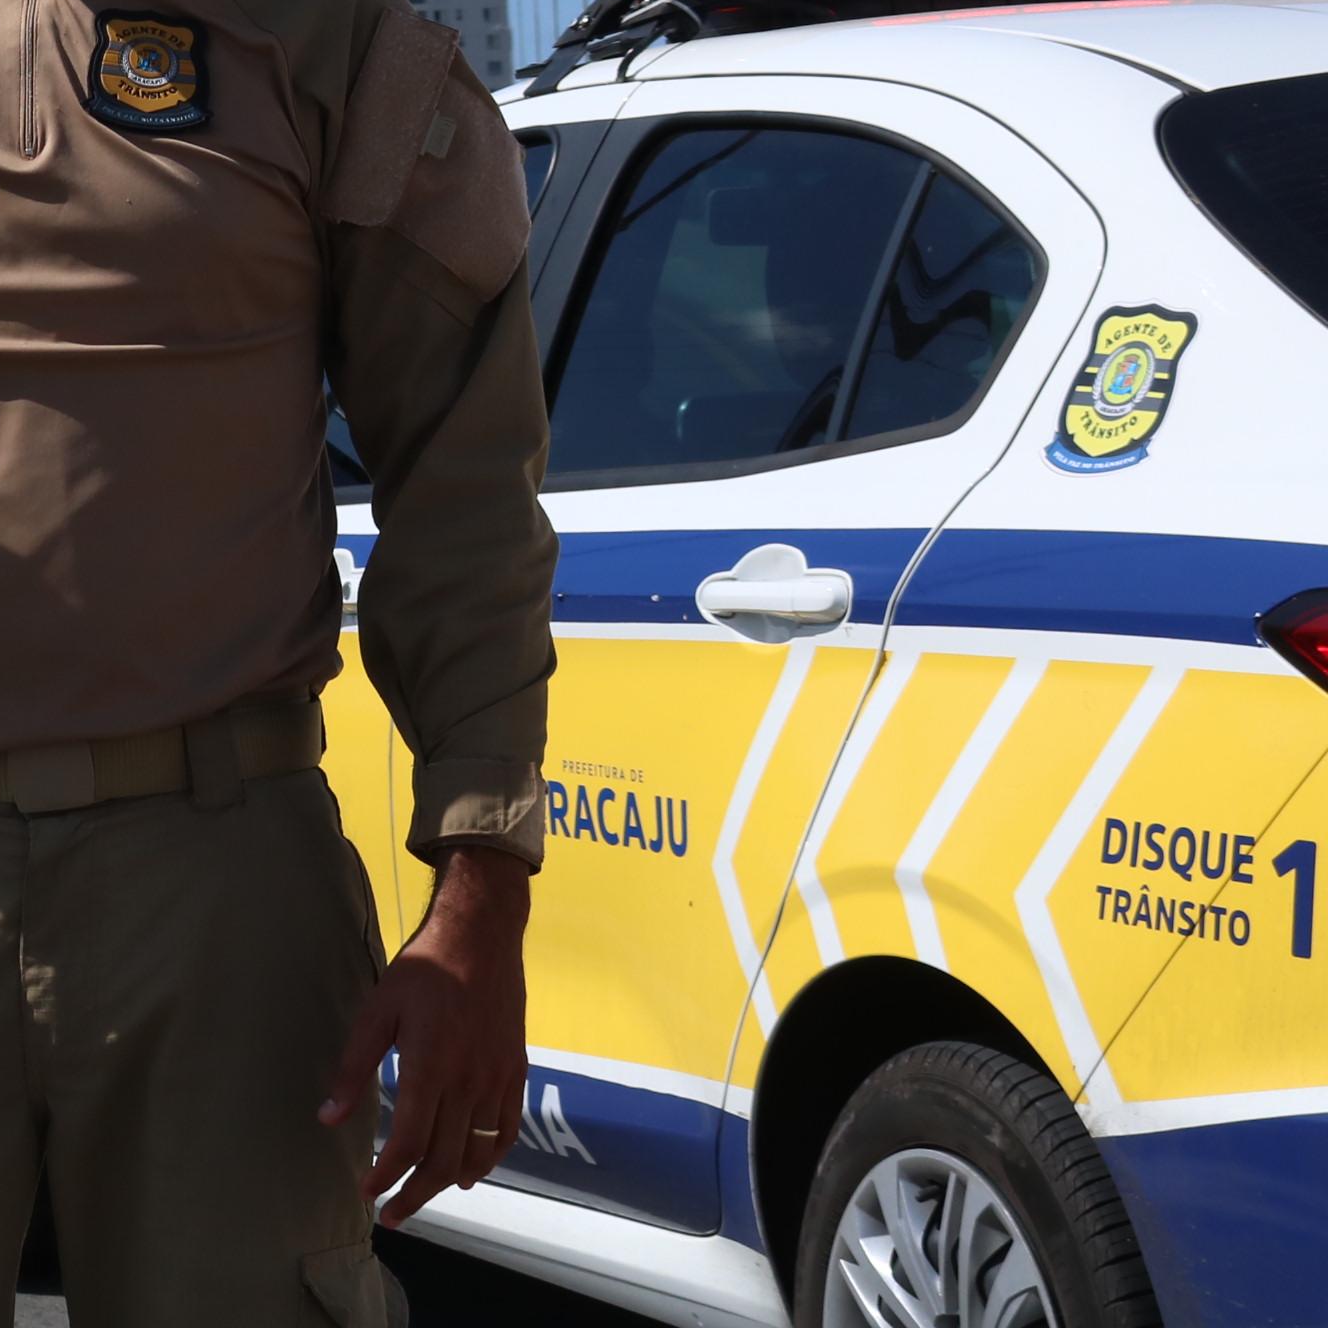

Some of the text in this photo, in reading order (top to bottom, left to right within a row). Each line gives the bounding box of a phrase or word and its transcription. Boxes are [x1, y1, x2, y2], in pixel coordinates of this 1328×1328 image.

[115, 27, 186, 49] AGENTE DE
[118, 80, 178, 100] TRÂNSITO
[1105, 323, 1172, 353] AGENTE DE
[562, 759, 645, 784] PREFEITURA DE
[545, 780, 688, 858] RACAJU
[1101, 817, 1256, 885] DISQUE
[1096, 883, 1251, 947] TRÂNSITO
